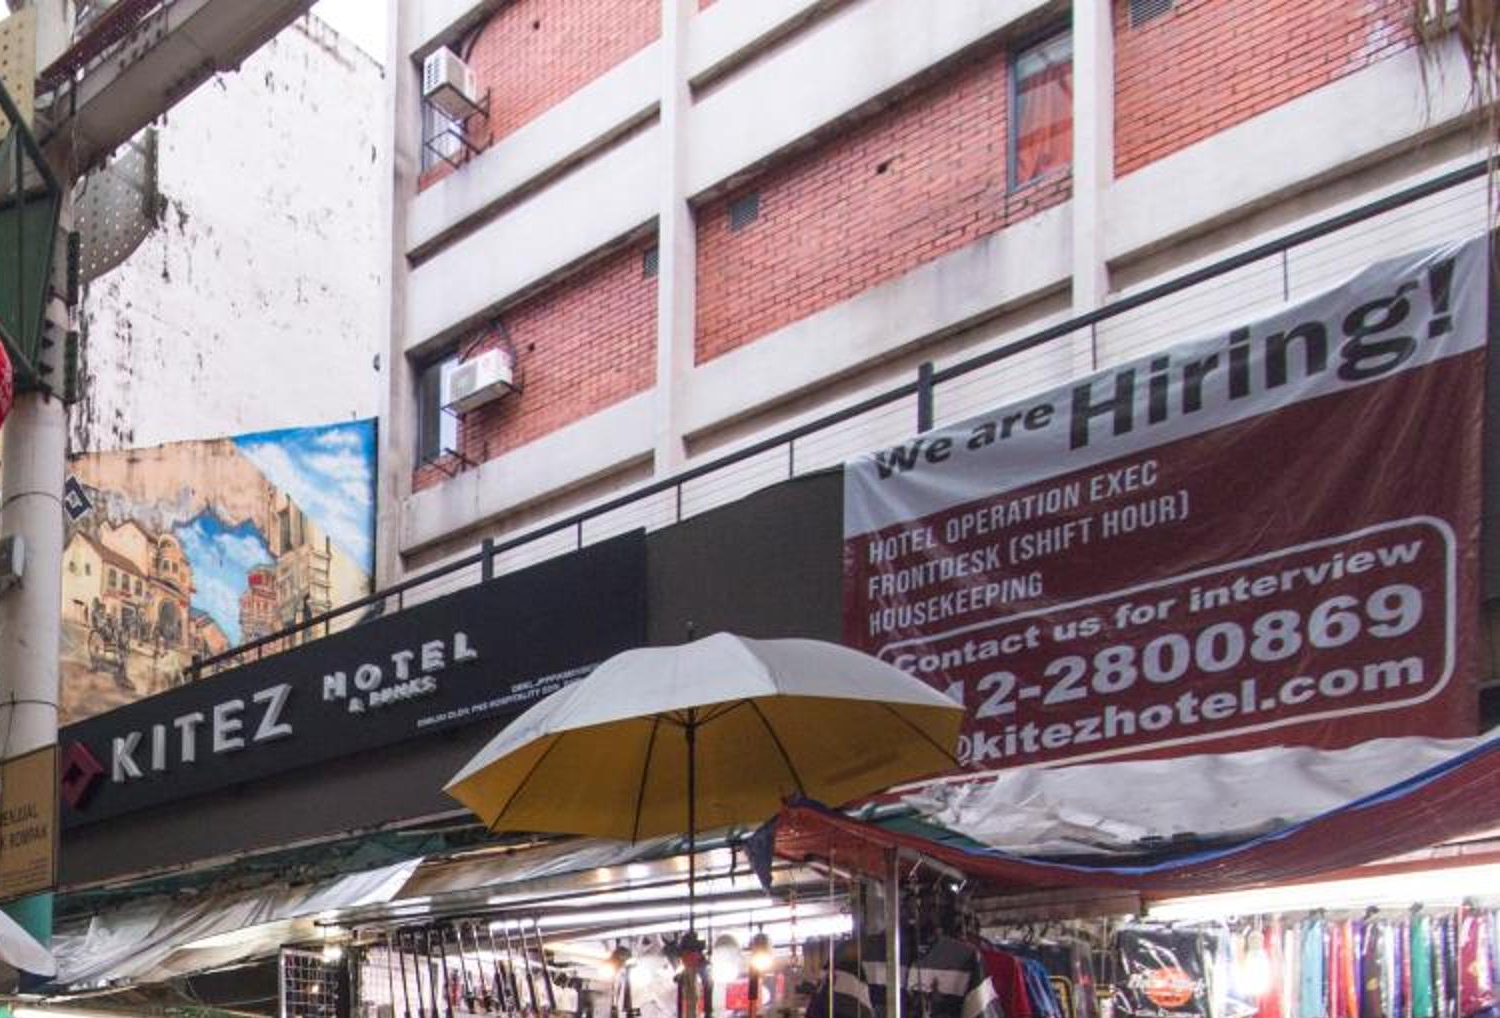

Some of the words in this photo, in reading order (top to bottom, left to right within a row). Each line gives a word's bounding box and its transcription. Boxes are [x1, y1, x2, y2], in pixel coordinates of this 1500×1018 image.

[875, 436, 953, 480] We
[966, 404, 1055, 452] are
[1069, 258, 1457, 451] Hiring!
[867, 542, 1000, 600] FRONTDESK
[868, 527, 938, 565] HOTEL
[946, 481, 1080, 544] OPERATION
[1089, 459, 1158, 502] EXEC
[868, 571, 1044, 638] HOUSEKEEPING
[894, 624, 1042, 676] Contact
[1052, 615, 1101, 641] us
[1113, 598, 1178, 630] for
[1188, 541, 1423, 612] interview
[111, 682, 294, 784] KITEZ
[322, 631, 479, 702] HOTEL
